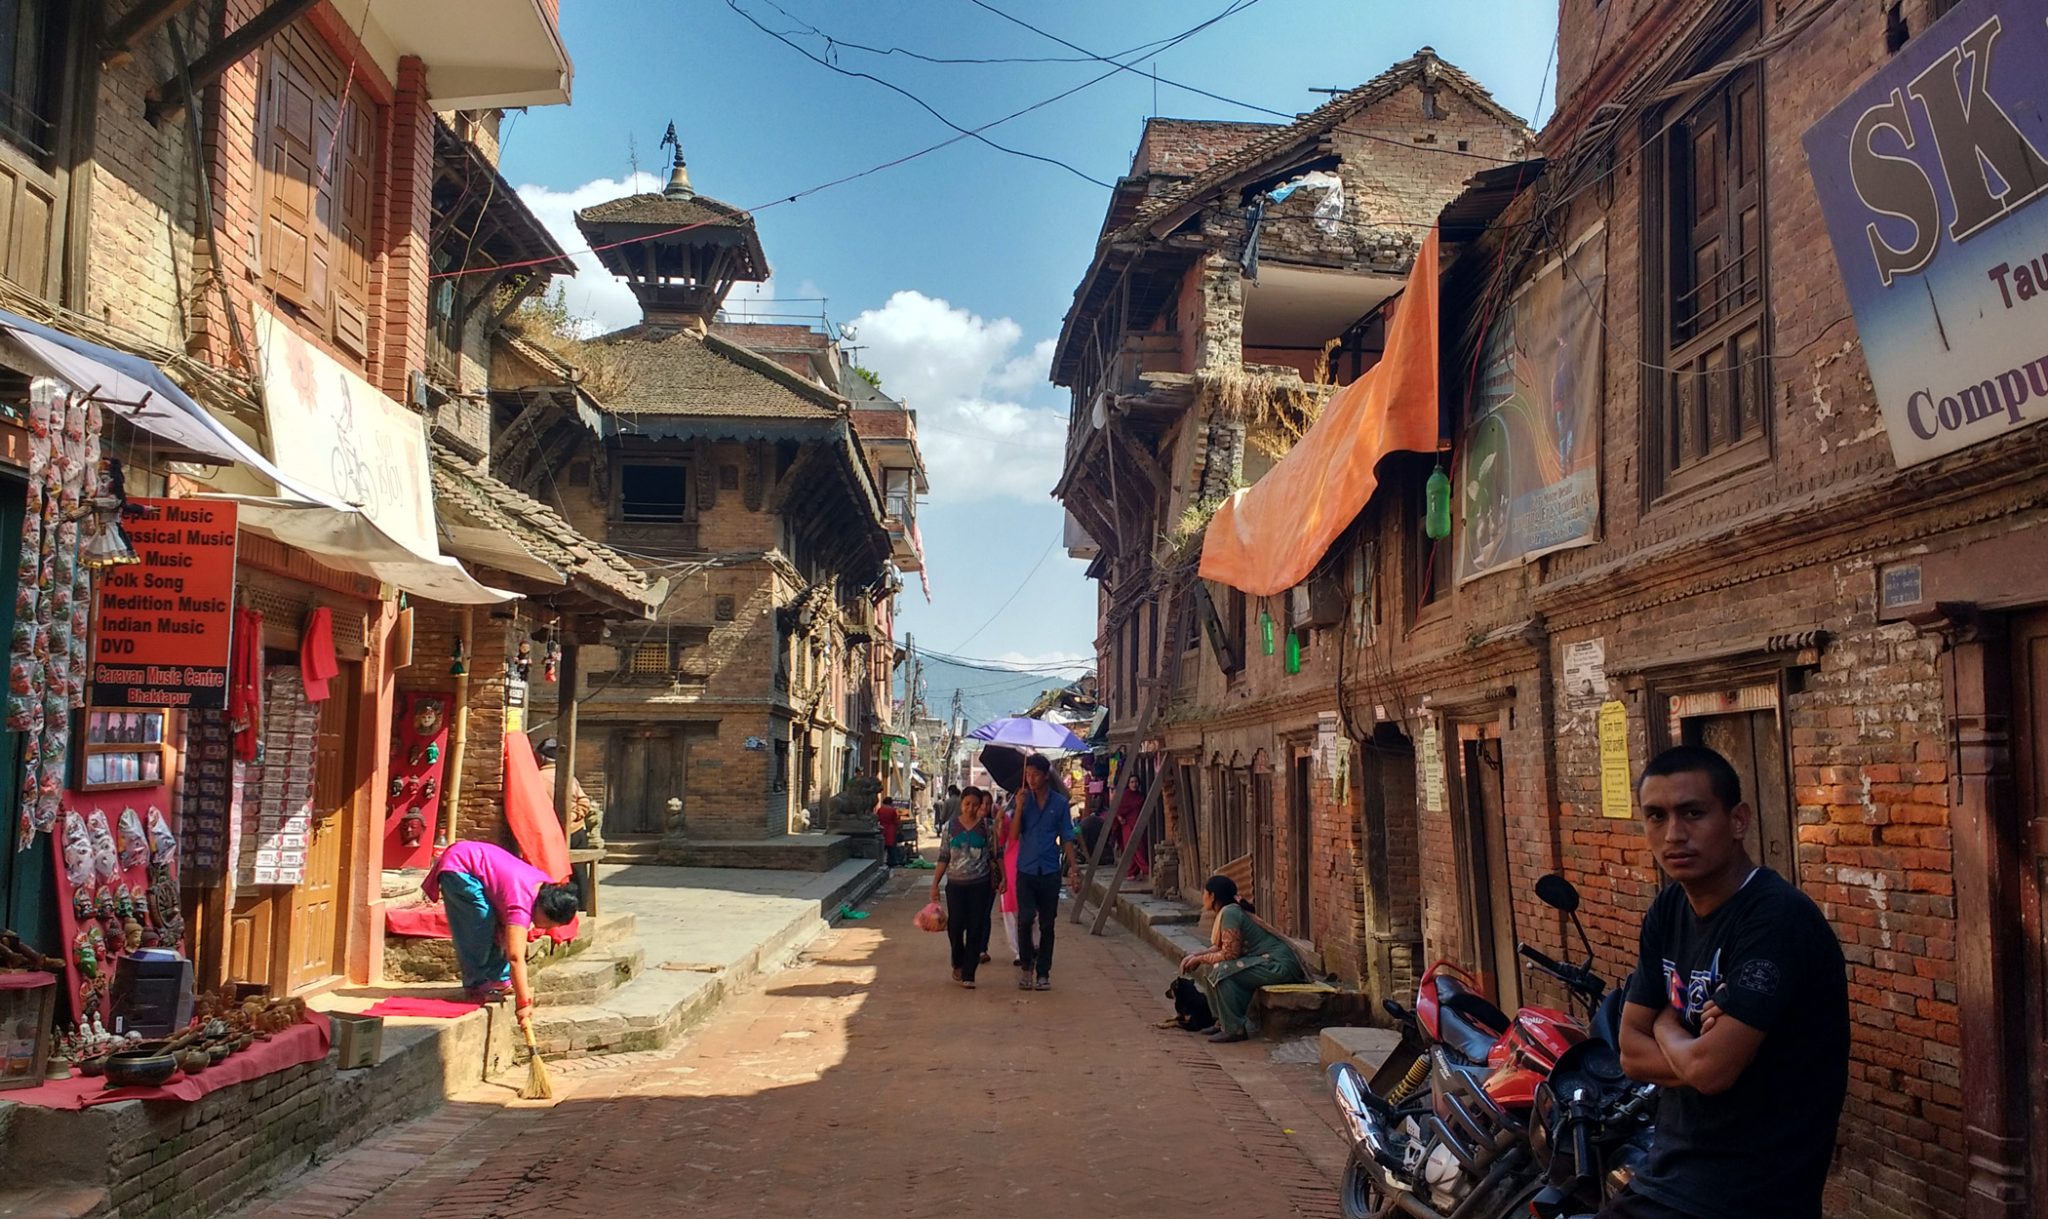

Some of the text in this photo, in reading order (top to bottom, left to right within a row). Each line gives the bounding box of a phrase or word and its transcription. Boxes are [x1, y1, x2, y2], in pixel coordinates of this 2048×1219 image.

[1849, 14, 2048, 288] SK
[166, 506, 214, 523] Music
[186, 531, 234, 546] Music
[145, 551, 193, 567] Music
[104, 572, 184, 593] Folk Song
[103, 594, 226, 613] Medition Music
[102, 616, 205, 634] Indian Music
[100, 639, 135, 654] DVD
[96, 665, 225, 687] Caravan Music Centre
[128, 688, 192, 707] Bhaktapur
